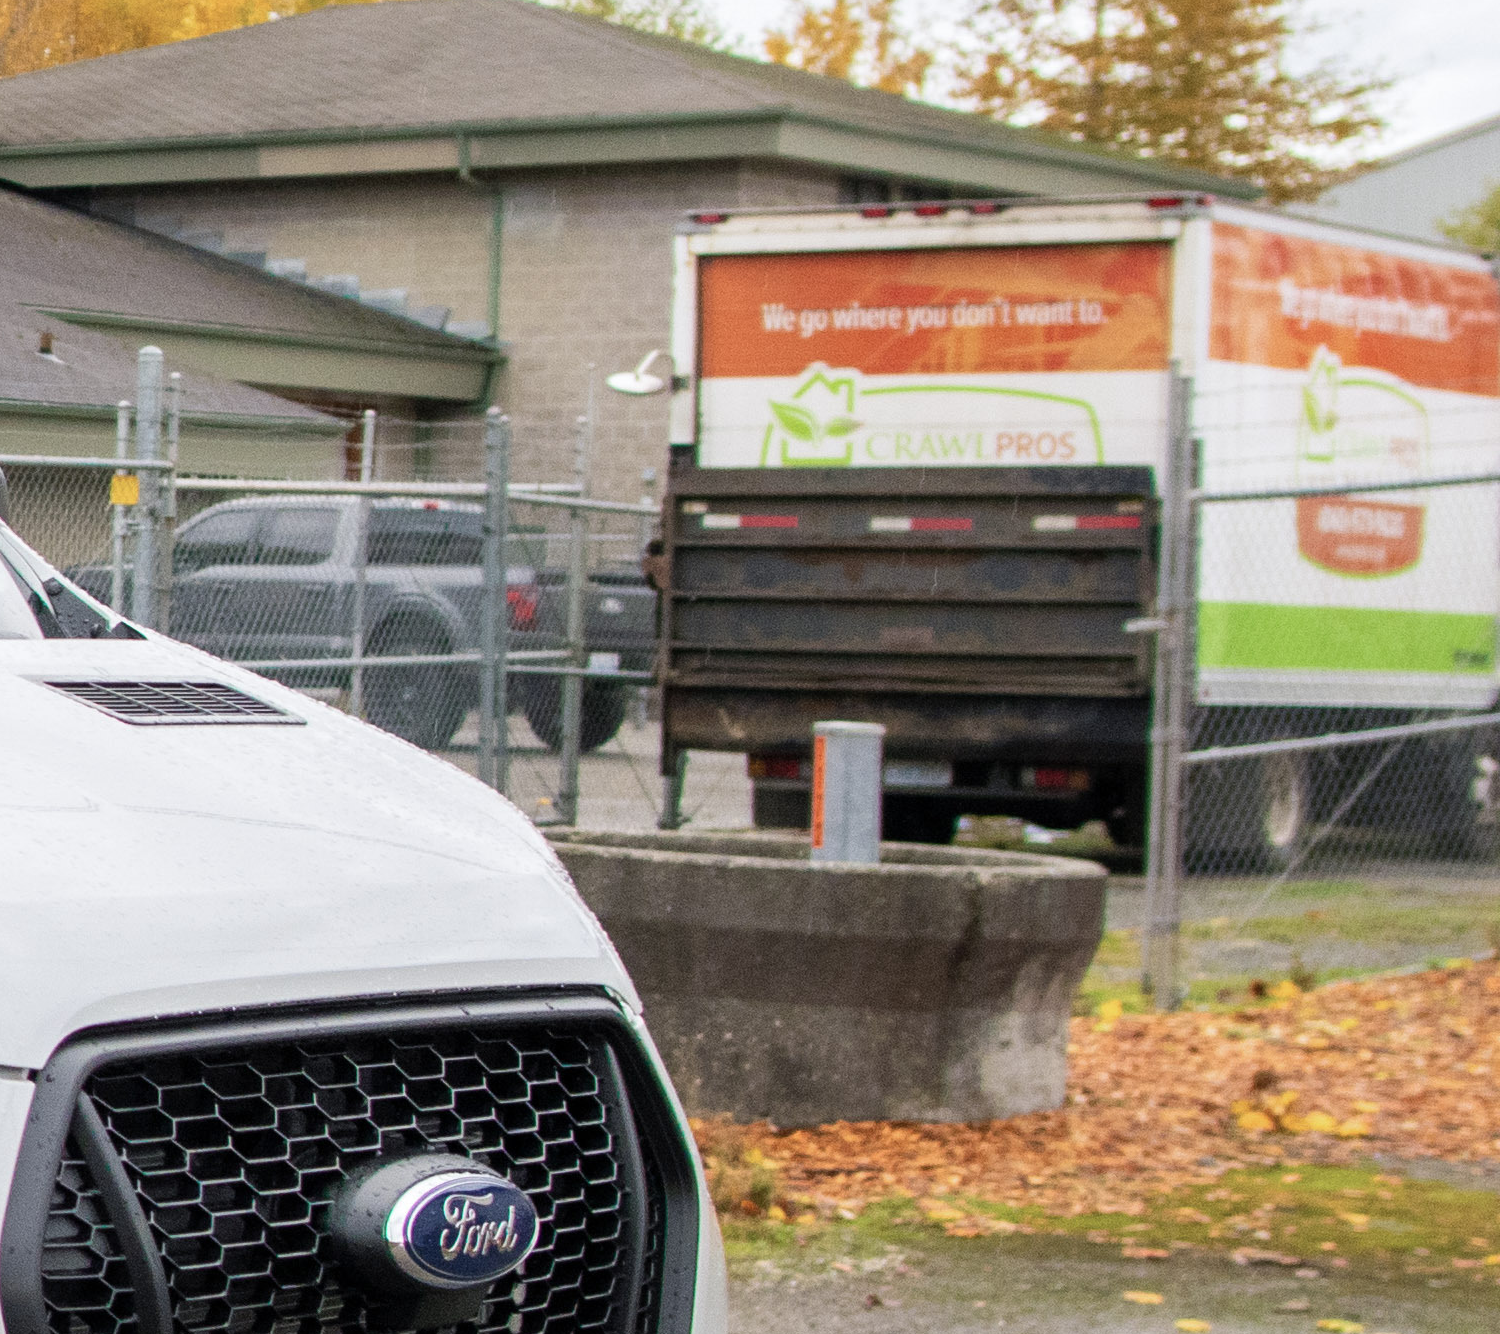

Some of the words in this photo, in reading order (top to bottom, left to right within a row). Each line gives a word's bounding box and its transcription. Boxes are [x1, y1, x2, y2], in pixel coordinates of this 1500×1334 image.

[761, 302, 796, 332] We
[799, 309, 829, 338] go
[832, 301, 903, 330] where
[906, 306, 947, 335] you
[951, 297, 1011, 328] don't
[1016, 299, 1073, 326] want
[440, 1193, 518, 1261] Ford
